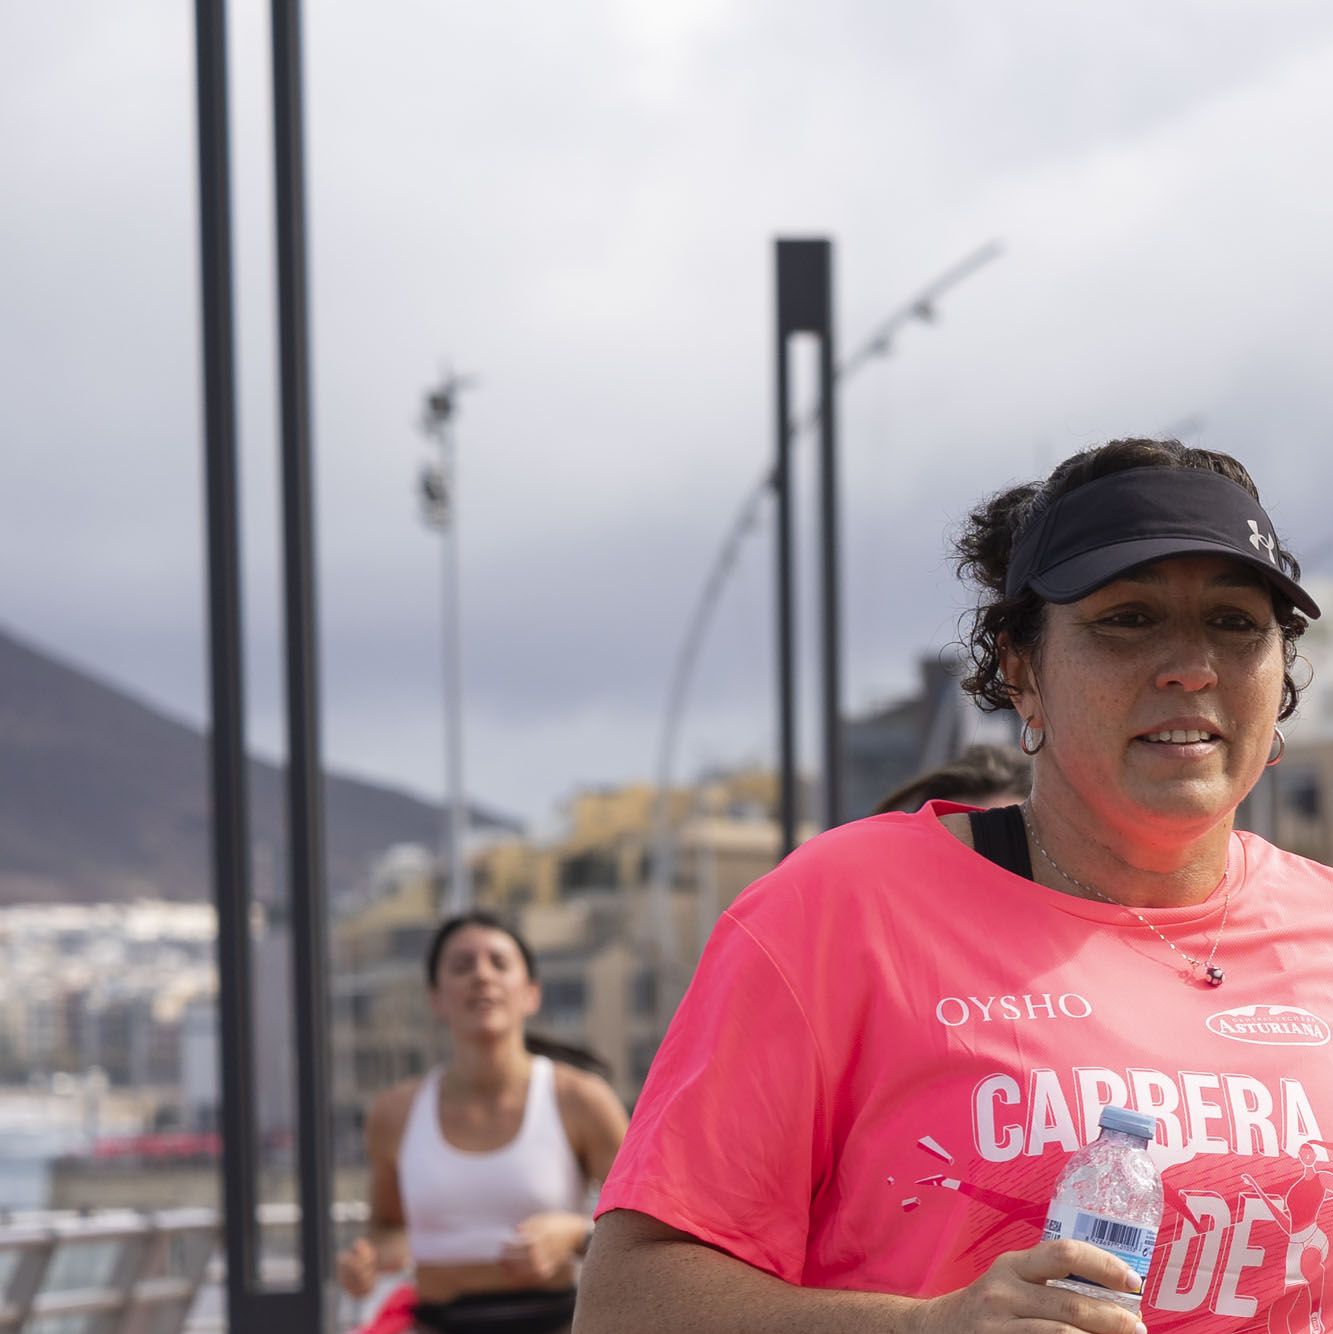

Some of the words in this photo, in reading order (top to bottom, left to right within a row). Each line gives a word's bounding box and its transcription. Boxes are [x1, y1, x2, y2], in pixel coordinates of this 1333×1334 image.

[936, 992, 1093, 1027] OYSHO
[1219, 1018, 1325, 1040] ASTURIANA
[971, 1066, 1330, 1163] CARRERA
[1149, 1189, 1290, 1319] DE
